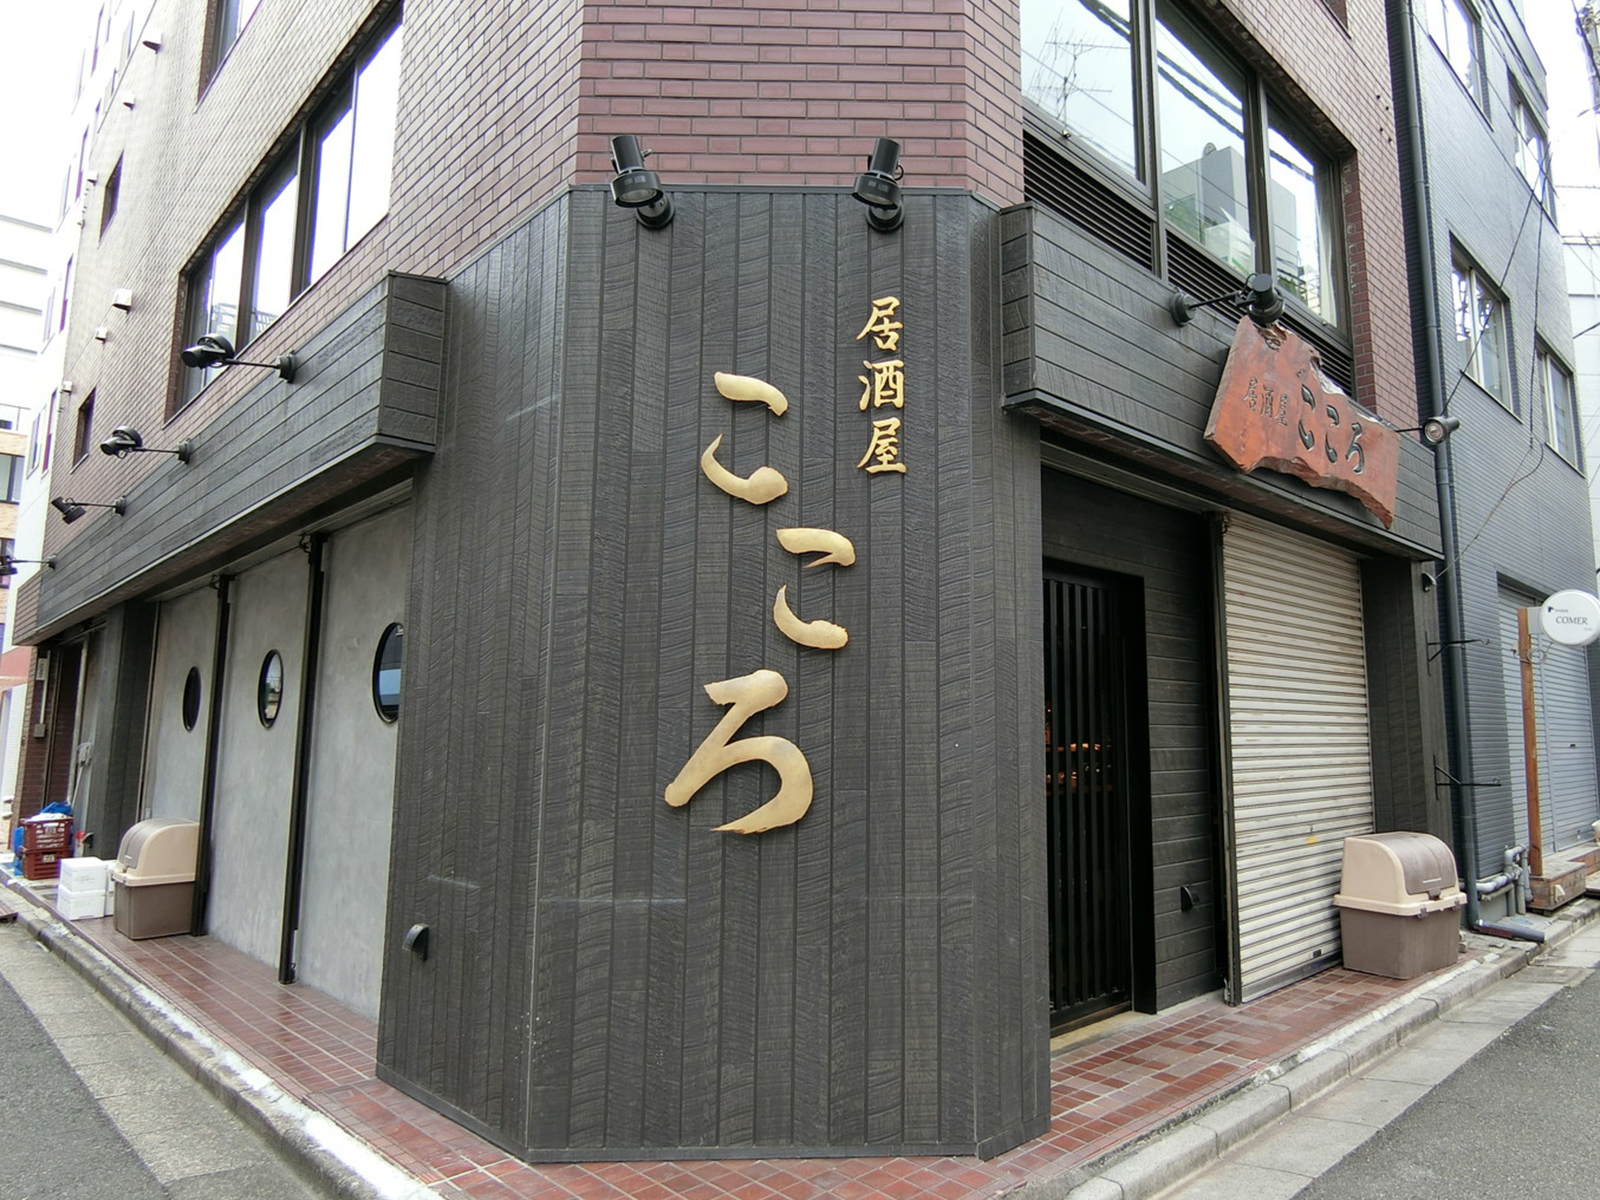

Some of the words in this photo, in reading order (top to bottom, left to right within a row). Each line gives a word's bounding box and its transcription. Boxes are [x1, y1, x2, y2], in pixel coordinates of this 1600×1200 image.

[856, 296, 907, 474] 居酒屋
[1243, 376, 1288, 426] 居酒屋
[1298, 384, 1365, 474] こころ
[664, 371, 856, 834] こころ
[1555, 616, 1588, 625] COMER
